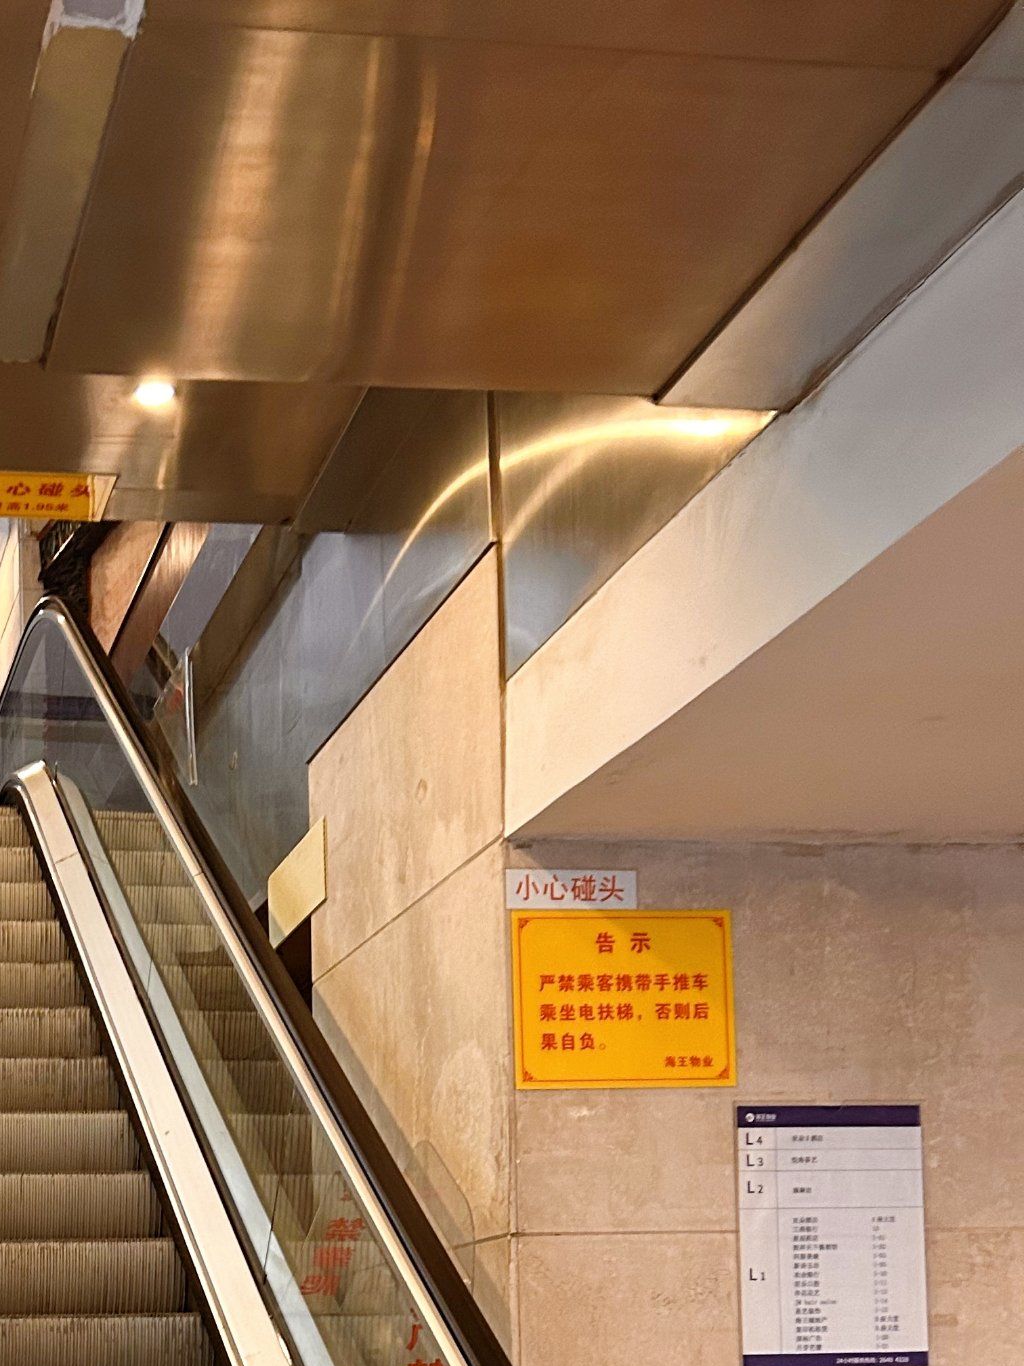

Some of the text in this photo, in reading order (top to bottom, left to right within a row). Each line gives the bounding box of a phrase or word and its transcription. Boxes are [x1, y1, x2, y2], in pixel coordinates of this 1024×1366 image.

[516, 873, 625, 902] 小心碰头
[595, 932, 651, 954] 告示
[539, 973, 709, 992] 严禁乘客携带手推车
[664, 1056, 714, 1068] 海王物业
